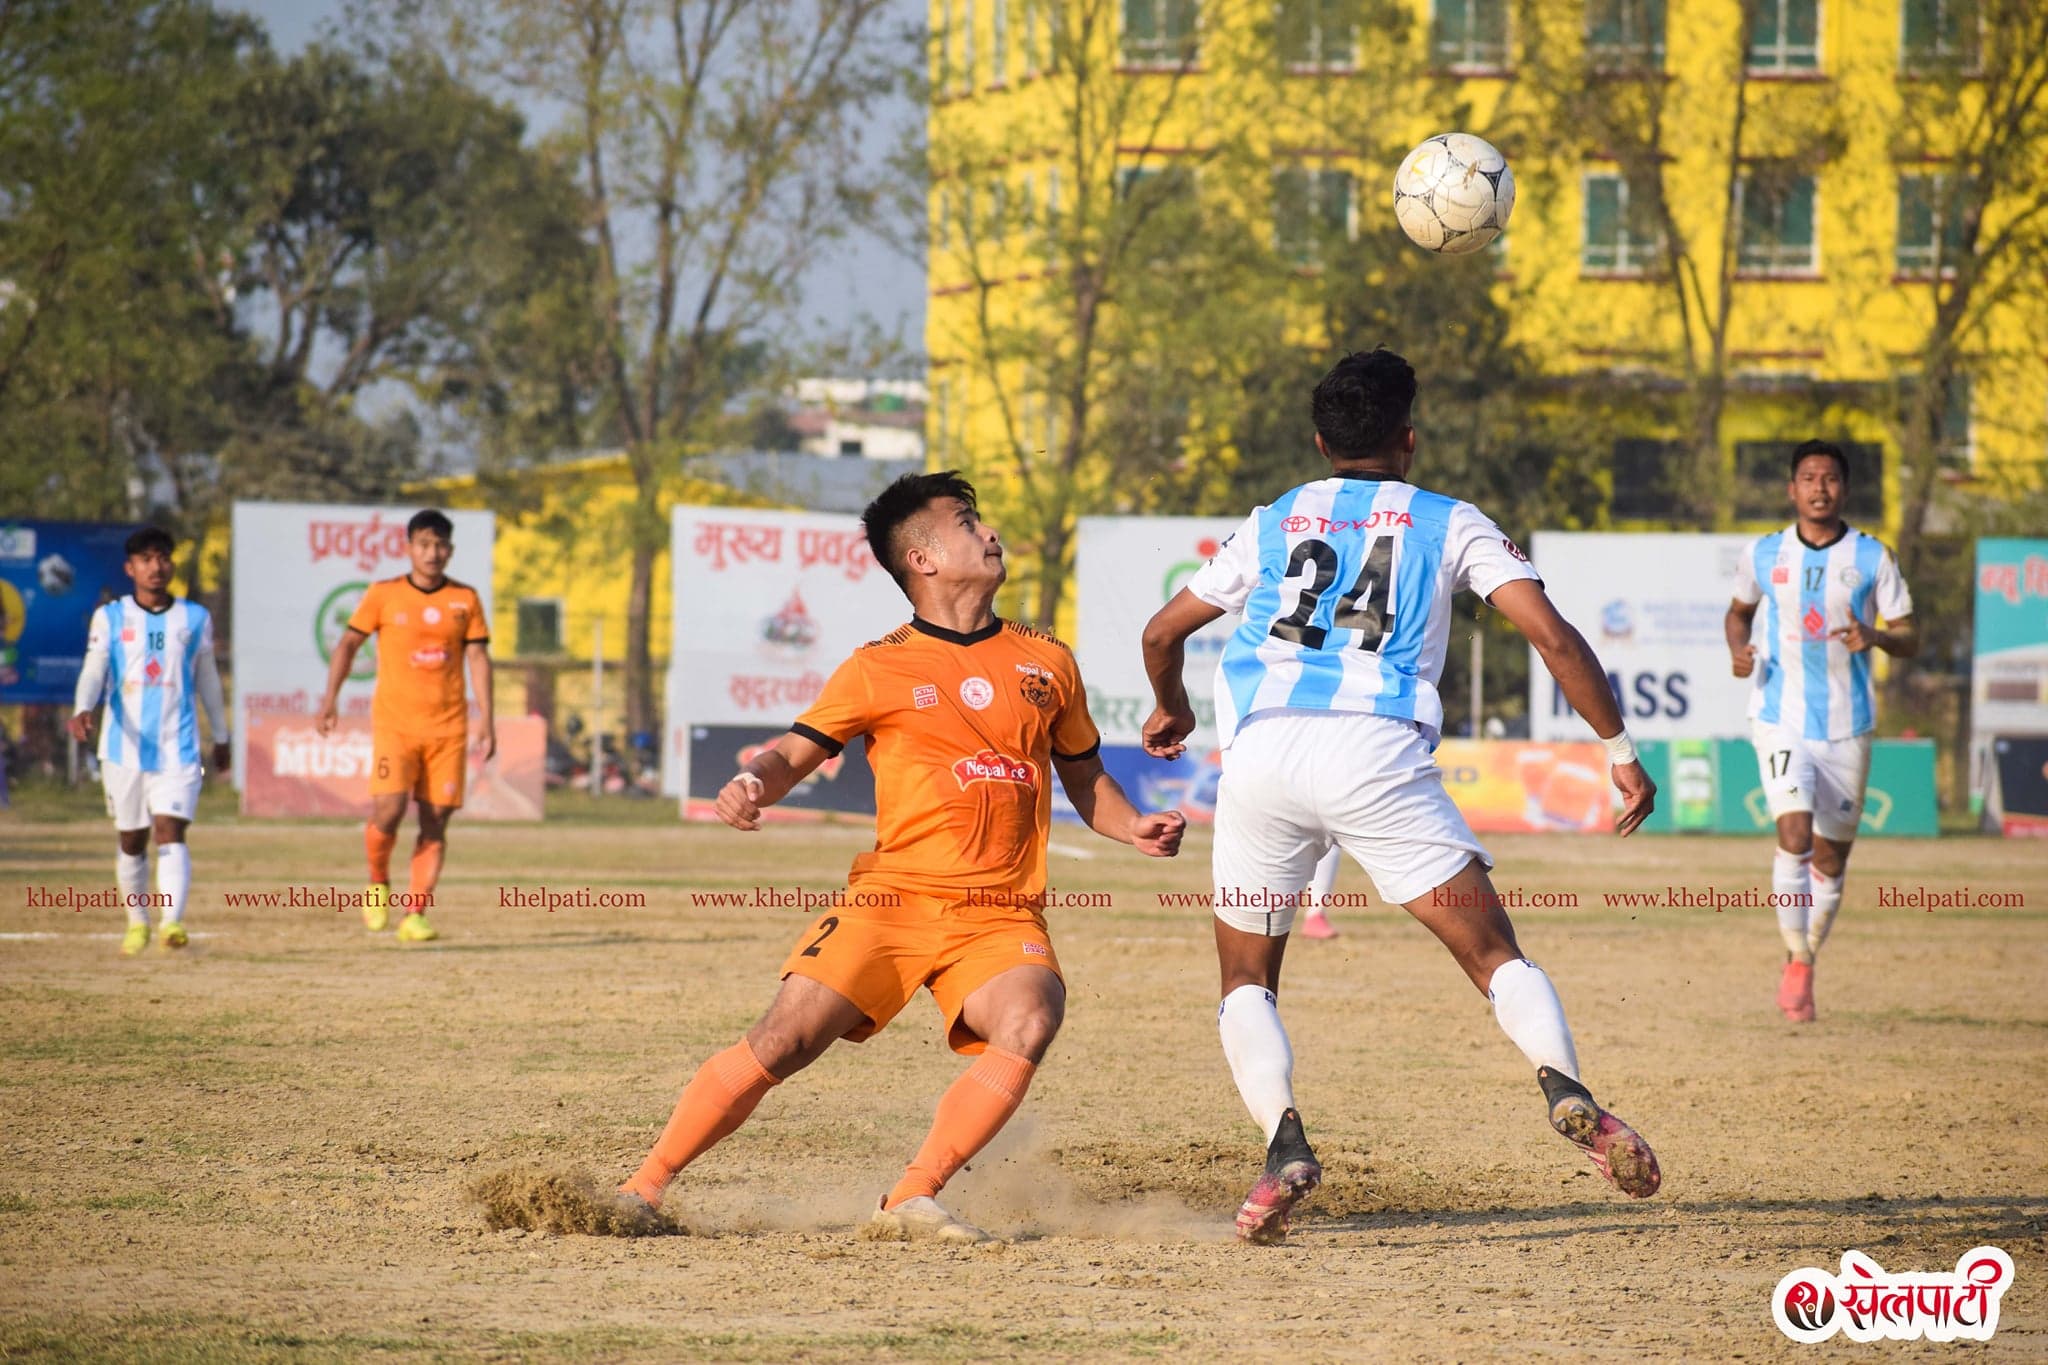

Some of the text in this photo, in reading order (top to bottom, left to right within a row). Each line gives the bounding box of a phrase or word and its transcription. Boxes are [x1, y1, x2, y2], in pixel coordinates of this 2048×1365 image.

[1316, 511, 1414, 533] TOYOTA
[1804, 566, 1825, 593] 17
[1268, 536, 1397, 652] 24
[148, 631, 166, 651] 18
[378, 757, 390, 780] 6
[966, 761, 1006, 780] Nepal
[1768, 750, 1791, 779] 17
[801, 916, 839, 958] 2
